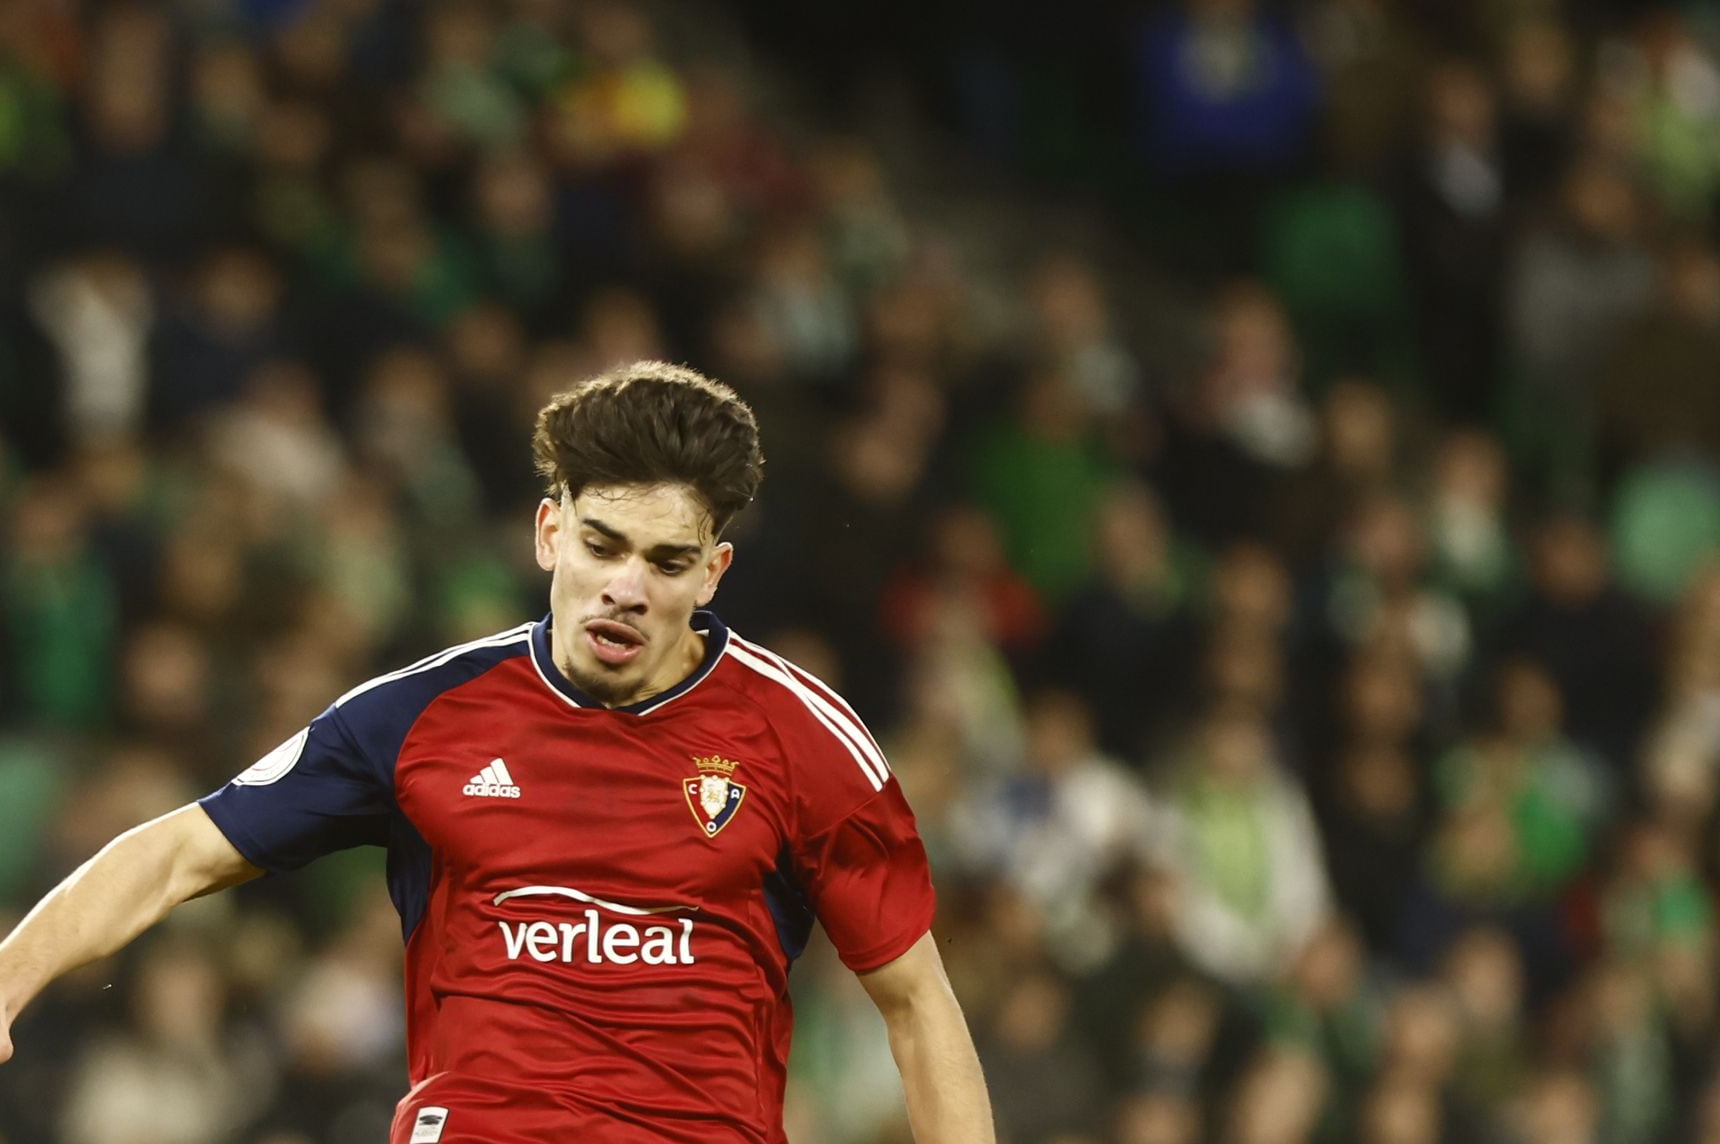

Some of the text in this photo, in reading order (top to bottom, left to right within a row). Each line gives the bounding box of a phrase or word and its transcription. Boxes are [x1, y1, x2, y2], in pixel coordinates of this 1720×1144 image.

[462, 784, 521, 799] adidas
[688, 783, 698, 795] C
[498, 909, 695, 965] verleal
